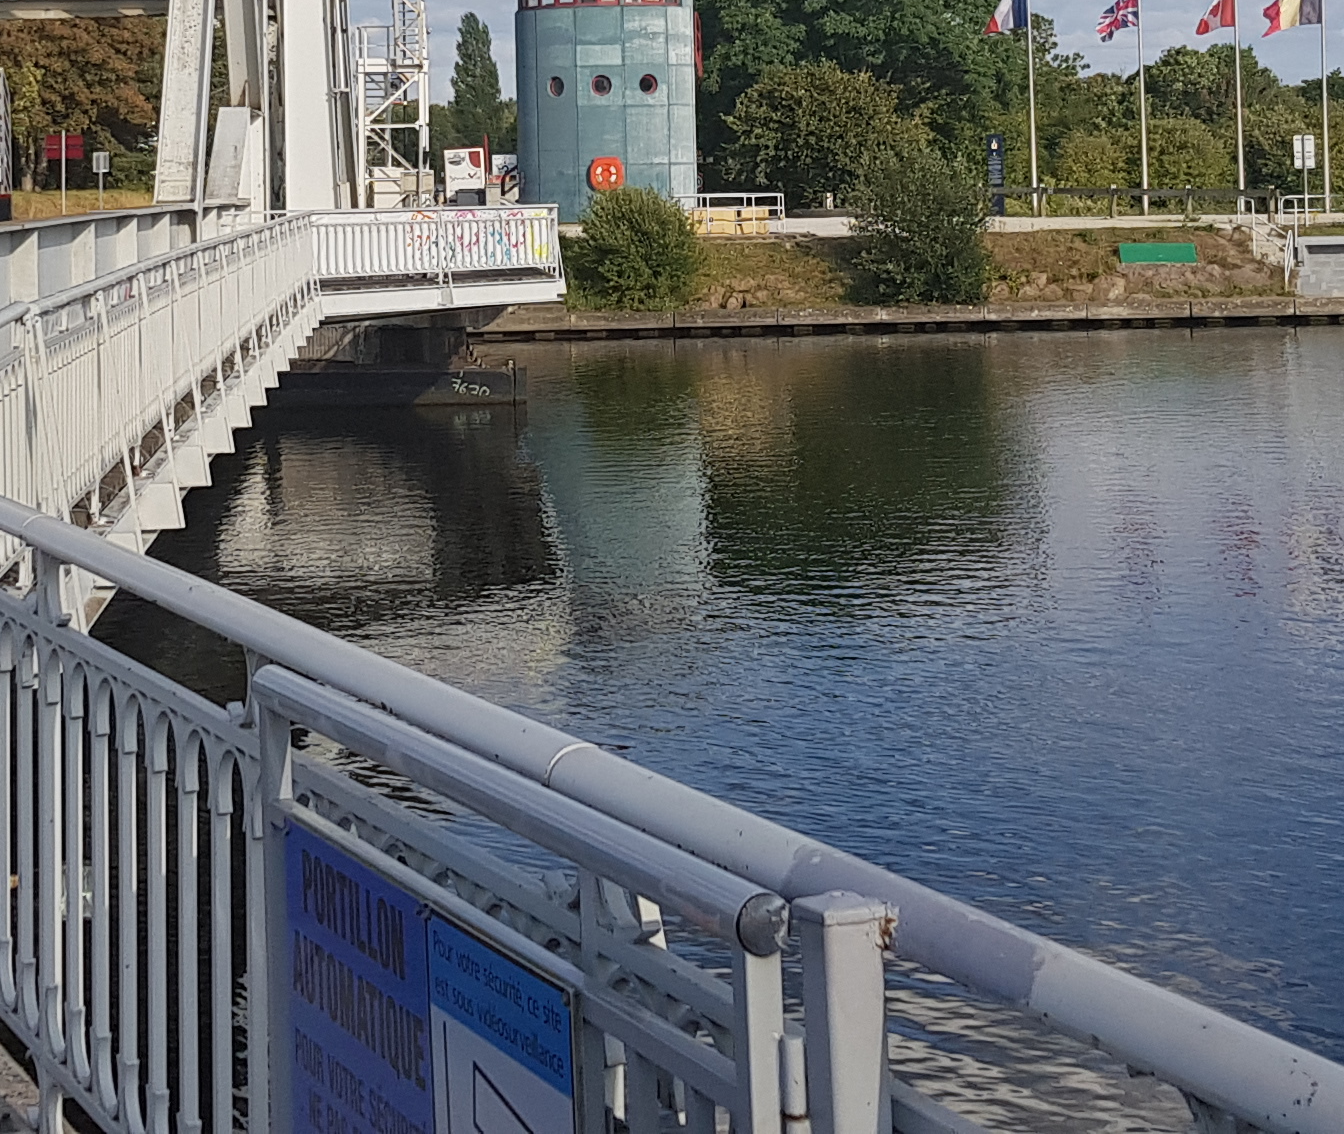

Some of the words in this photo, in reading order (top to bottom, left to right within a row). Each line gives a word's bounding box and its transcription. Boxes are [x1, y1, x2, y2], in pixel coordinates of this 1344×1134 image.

[301, 849, 405, 981] PORTILLON
[293, 928, 426, 1092] AUTOMATIQUE
[433, 929, 454, 962] Pour
[457, 952, 481, 982] votre
[527, 996, 539, 1018] ce
[543, 999, 562, 1034] site
[435, 976, 450, 1002] est
[453, 987, 474, 1017] sous
[477, 1002, 564, 1079] vidéosurveillance
[295, 1027, 324, 1085] POUR
[328, 1053, 365, 1118] VOTRE
[369, 1084, 426, 1134] SÉCUR
